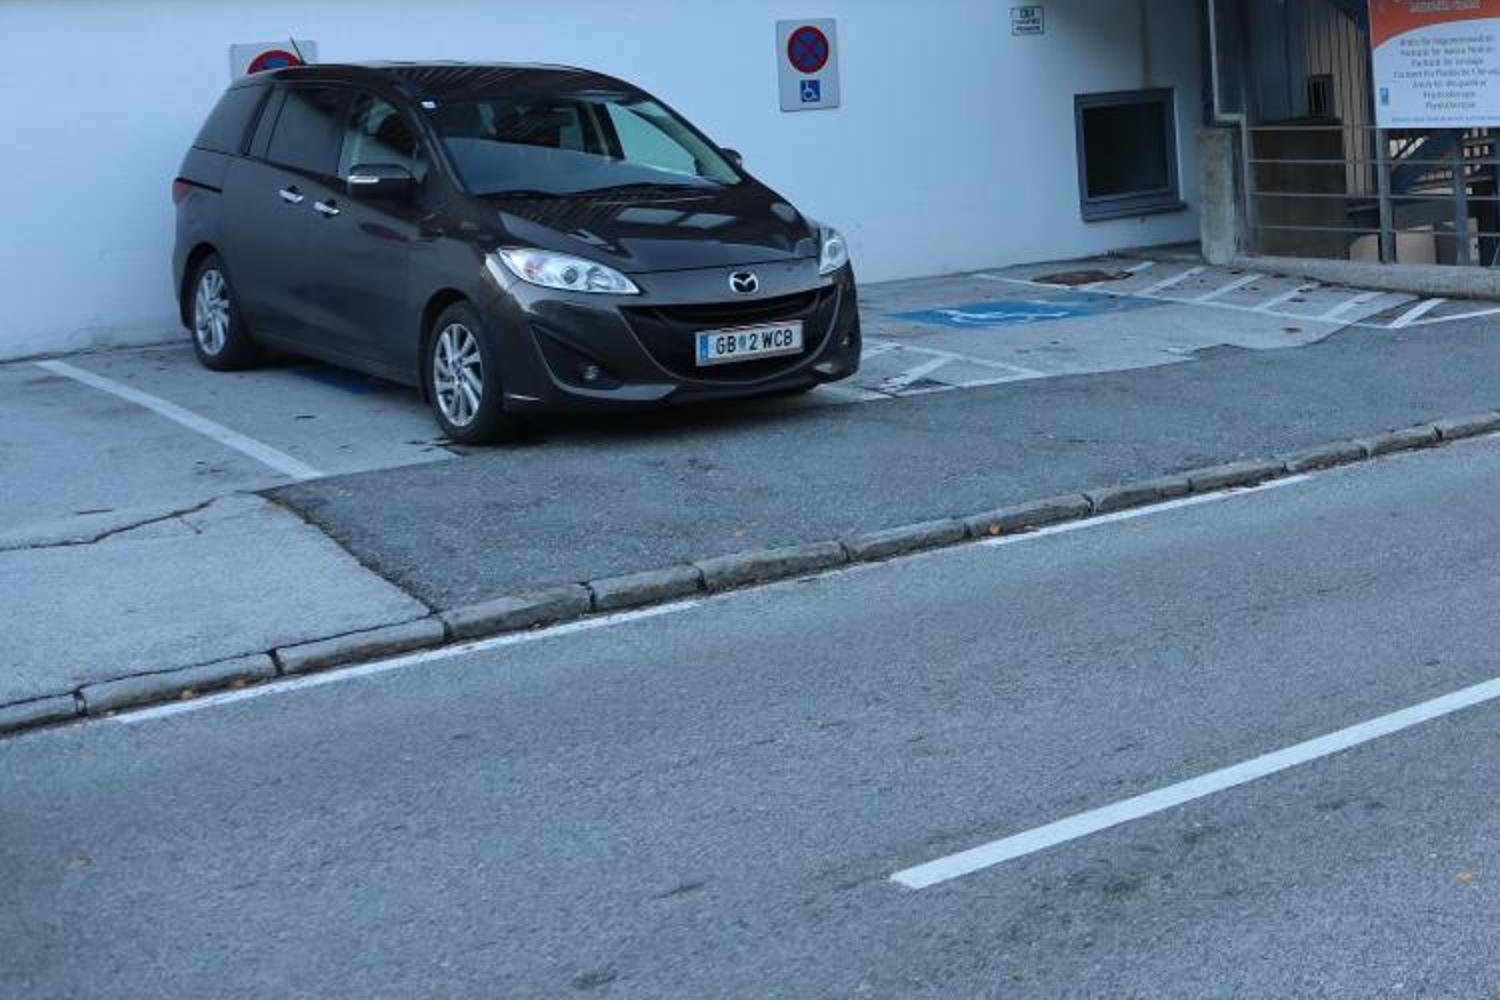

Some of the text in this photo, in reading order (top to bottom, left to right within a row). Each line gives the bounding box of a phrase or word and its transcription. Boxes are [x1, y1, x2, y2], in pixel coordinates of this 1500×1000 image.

[716, 329, 793, 355] GB 2 WCB
